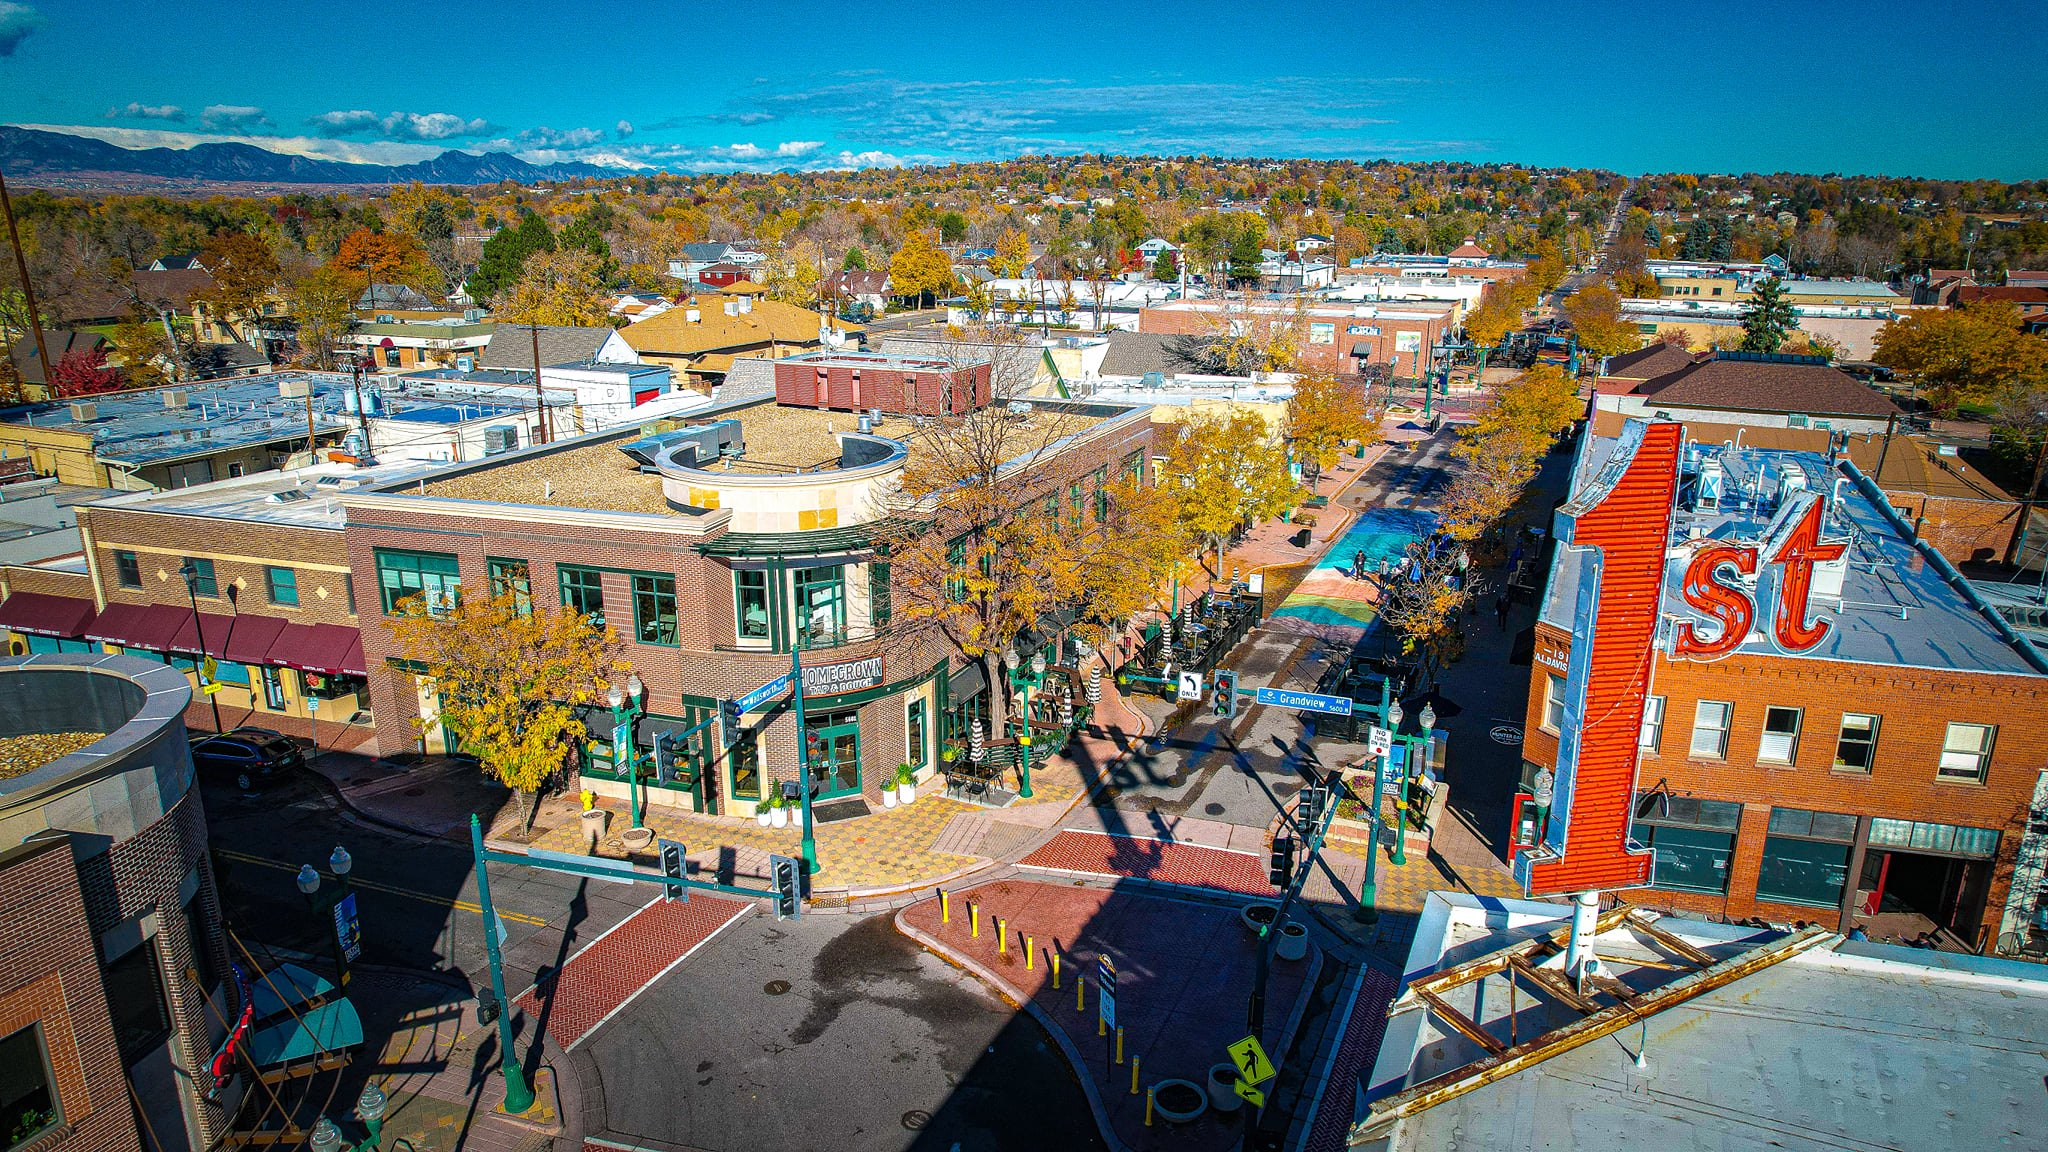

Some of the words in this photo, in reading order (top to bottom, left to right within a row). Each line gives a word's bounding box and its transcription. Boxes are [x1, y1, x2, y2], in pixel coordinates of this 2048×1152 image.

[1522, 421, 1851, 898] 1st
[801, 656, 883, 688] HOMEGROWN
[749, 683, 777, 705] Wadsworth
[809, 684, 830, 696] TAP
[830, 683, 839, 693] &
[839, 677, 874, 692] DOUGH
[1181, 690, 1199, 698] ONLY
[1280, 693, 1326, 708] Grandview
[1329, 705, 1344, 713] 5600
[1374, 735, 1387, 743] TURN
[1375, 729, 1387, 737] NO
